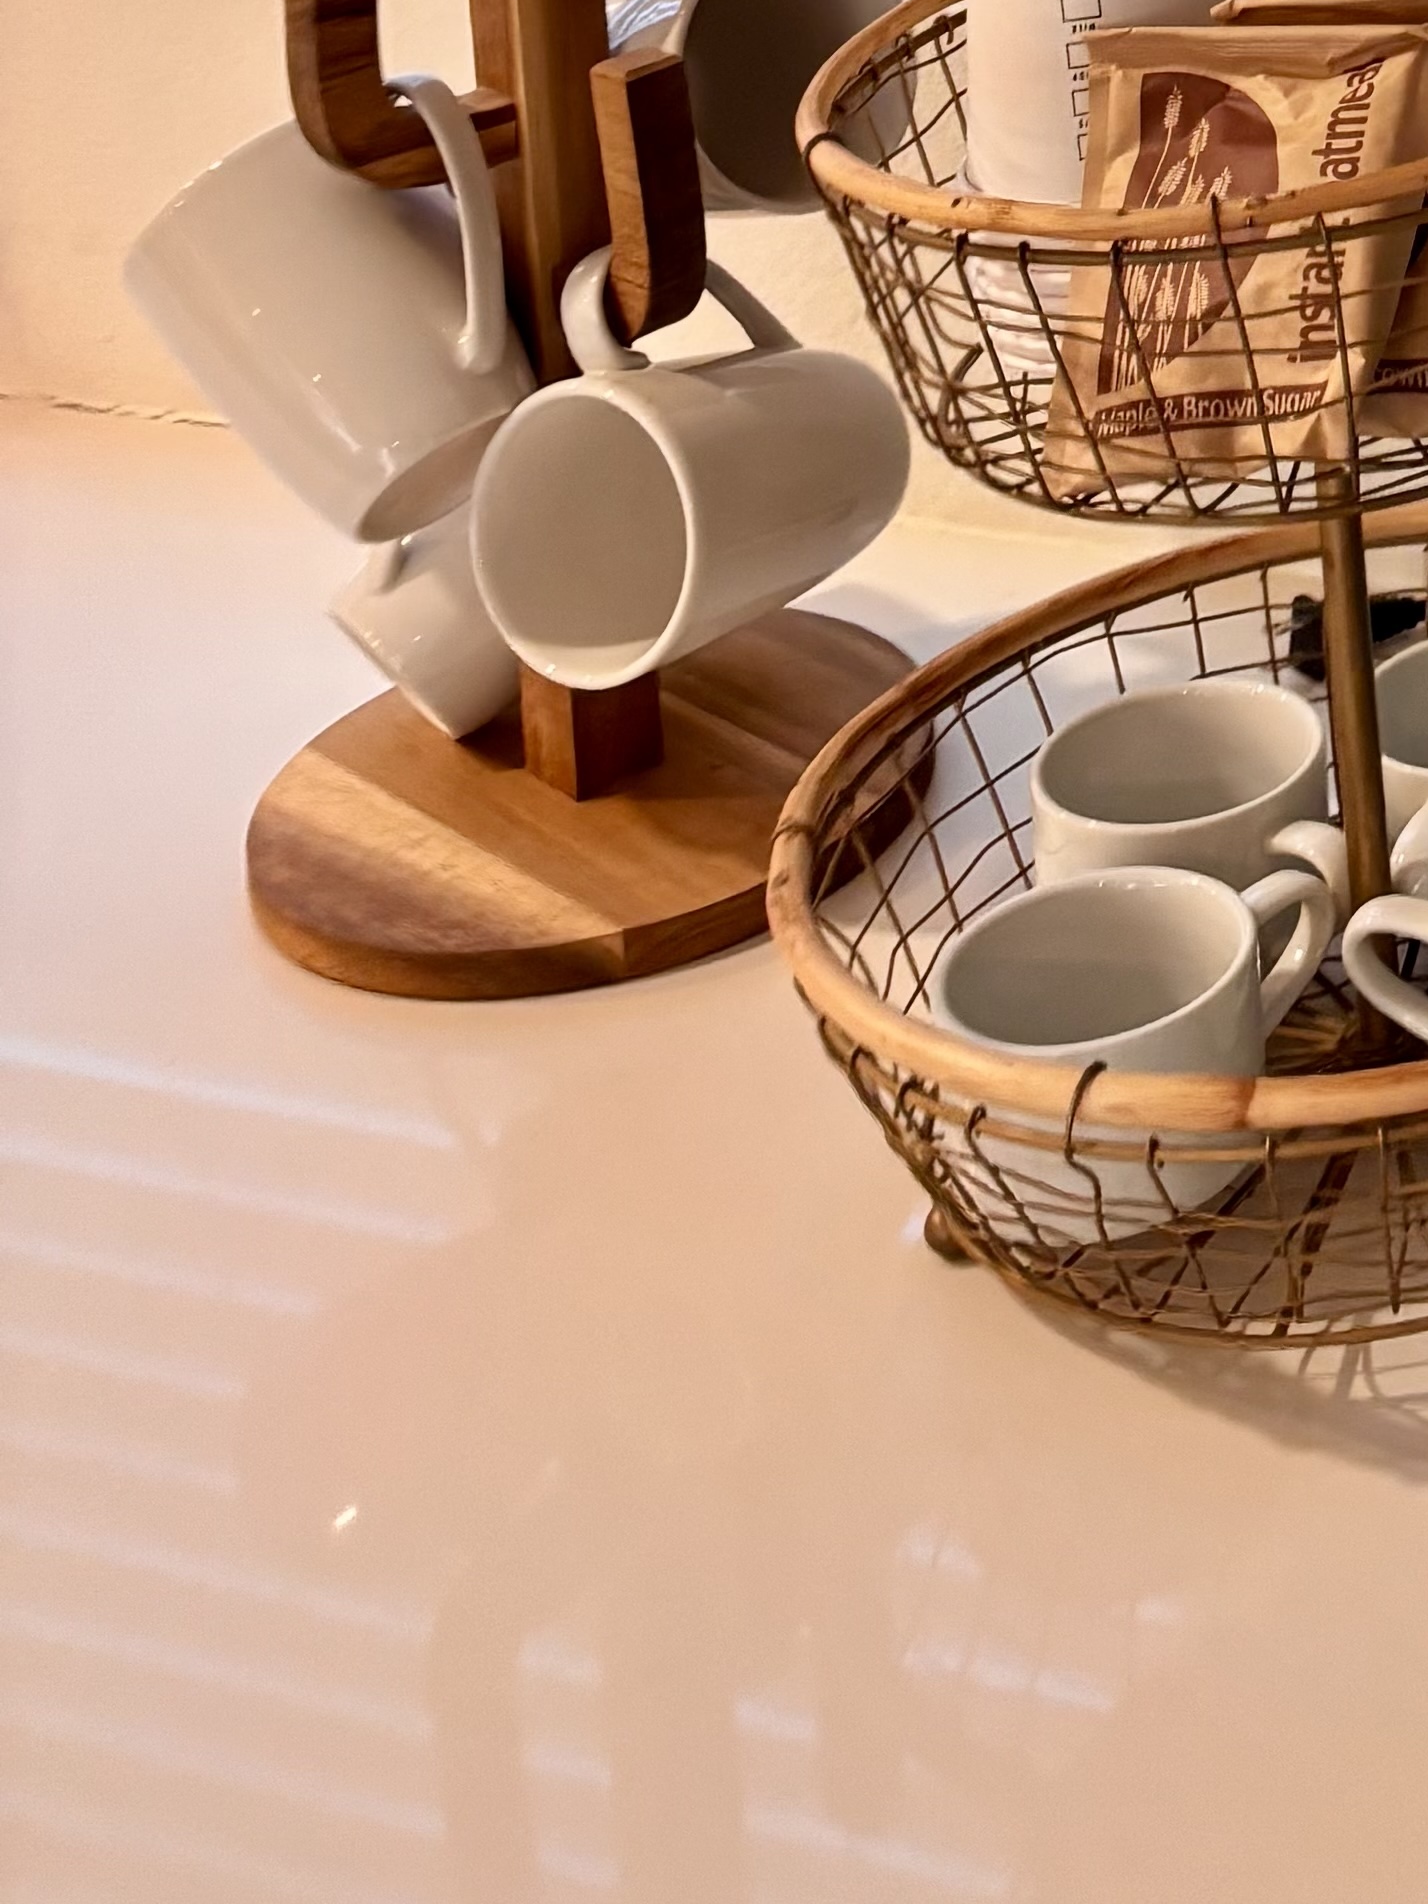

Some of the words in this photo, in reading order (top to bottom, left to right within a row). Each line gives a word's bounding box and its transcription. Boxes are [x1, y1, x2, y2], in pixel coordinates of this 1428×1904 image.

[1311, 60, 1383, 181] atmea
[1286, 215, 1351, 363] insta
[1163, 397, 1178, 420] &
[1182, 395, 1259, 421] Brown
